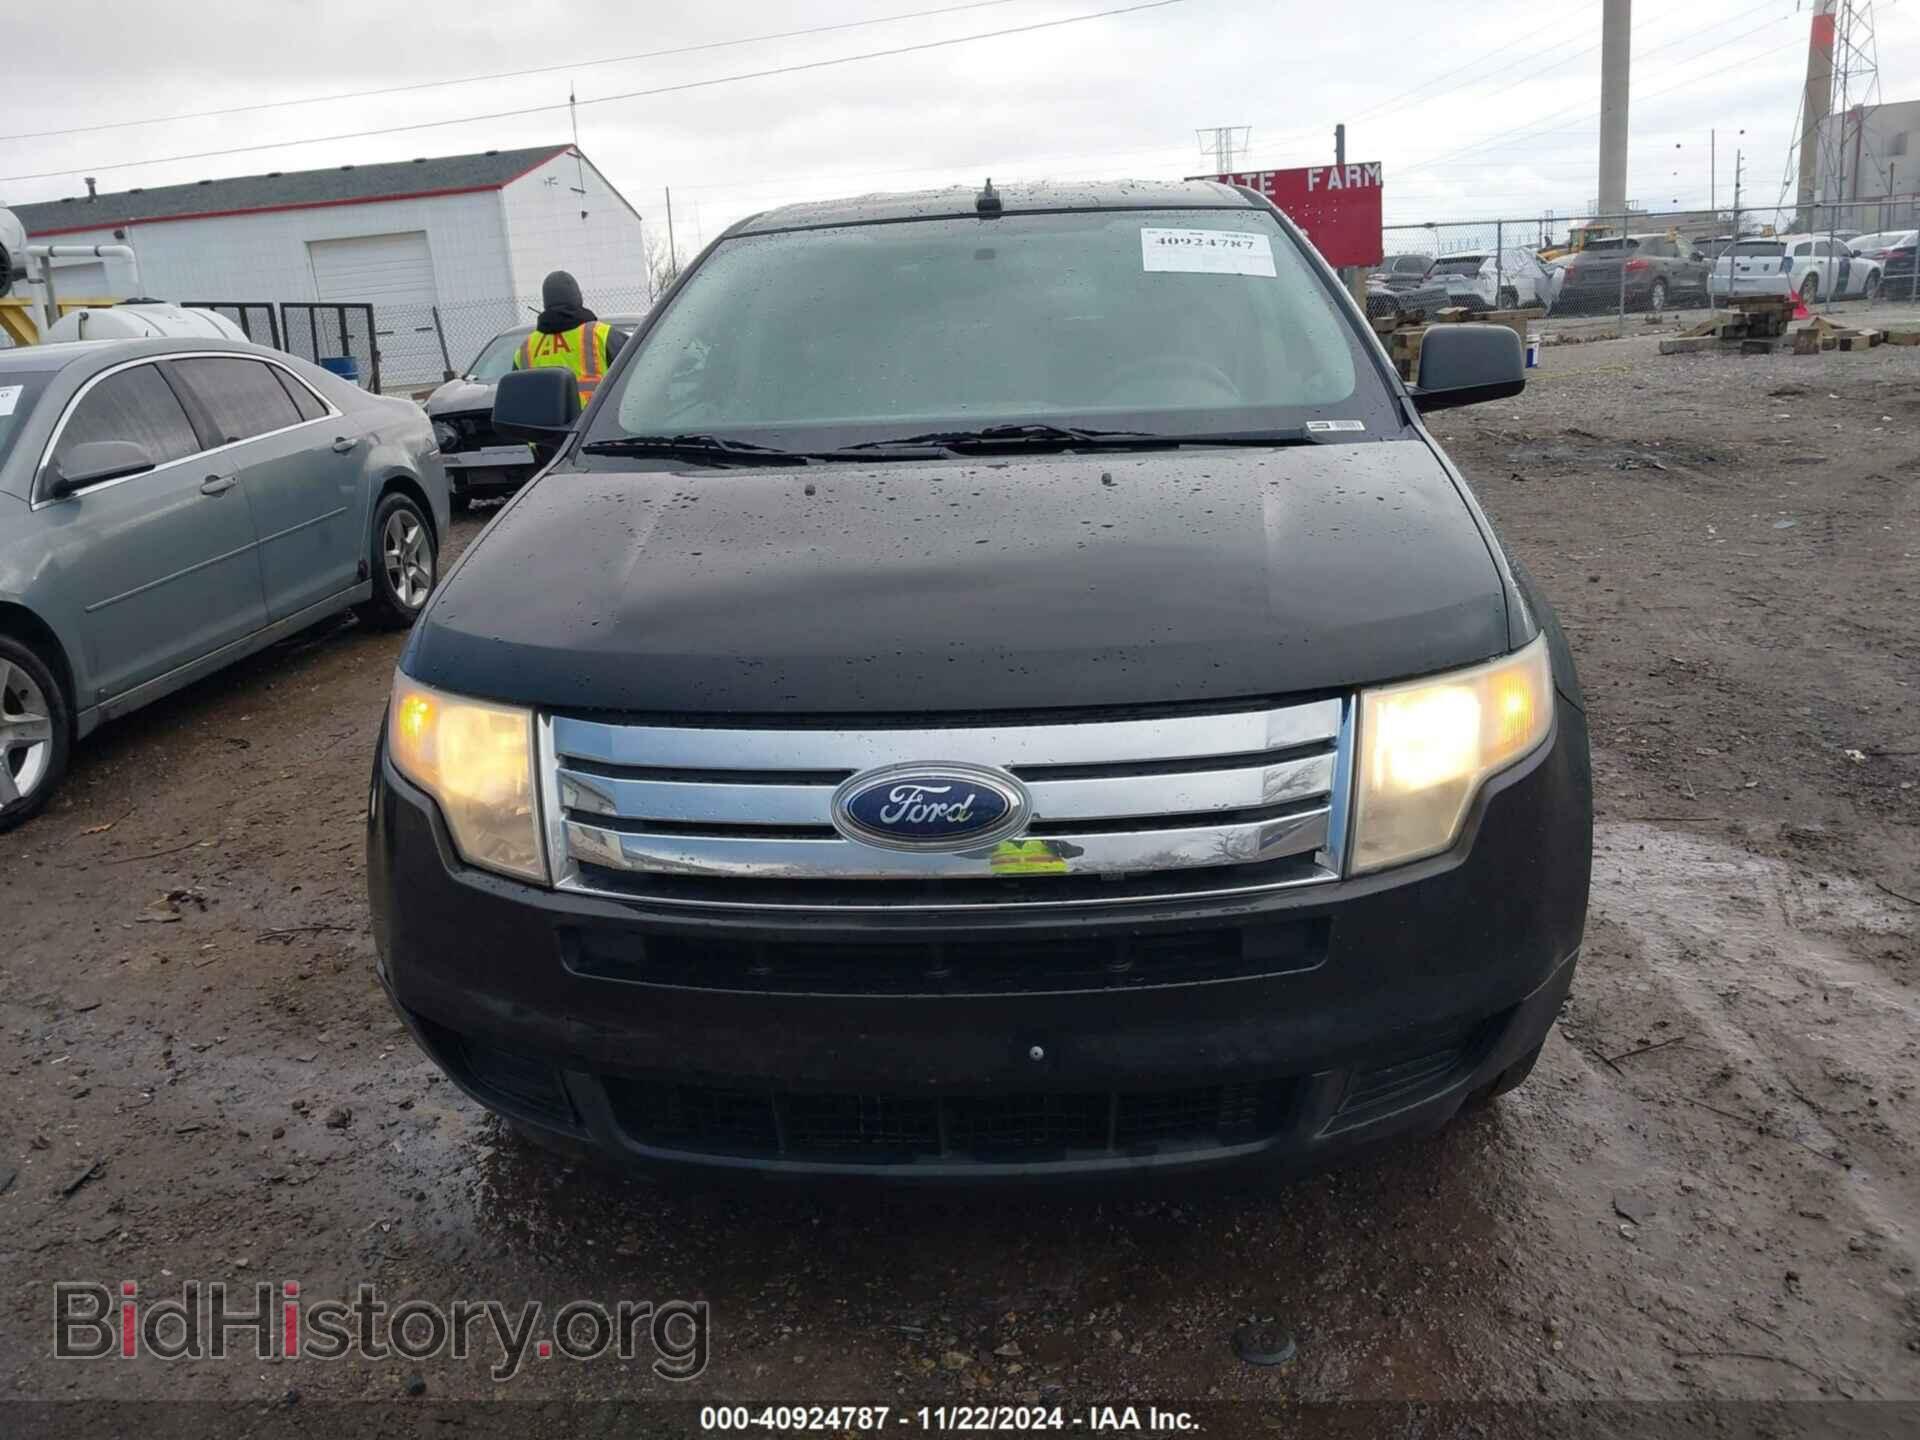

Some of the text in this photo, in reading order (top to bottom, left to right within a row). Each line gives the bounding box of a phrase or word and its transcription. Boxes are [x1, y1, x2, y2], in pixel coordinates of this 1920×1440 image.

[1307, 163, 1383, 192] FARM
[1156, 237, 1255, 250] 40924787
[879, 784, 976, 824] Ford
